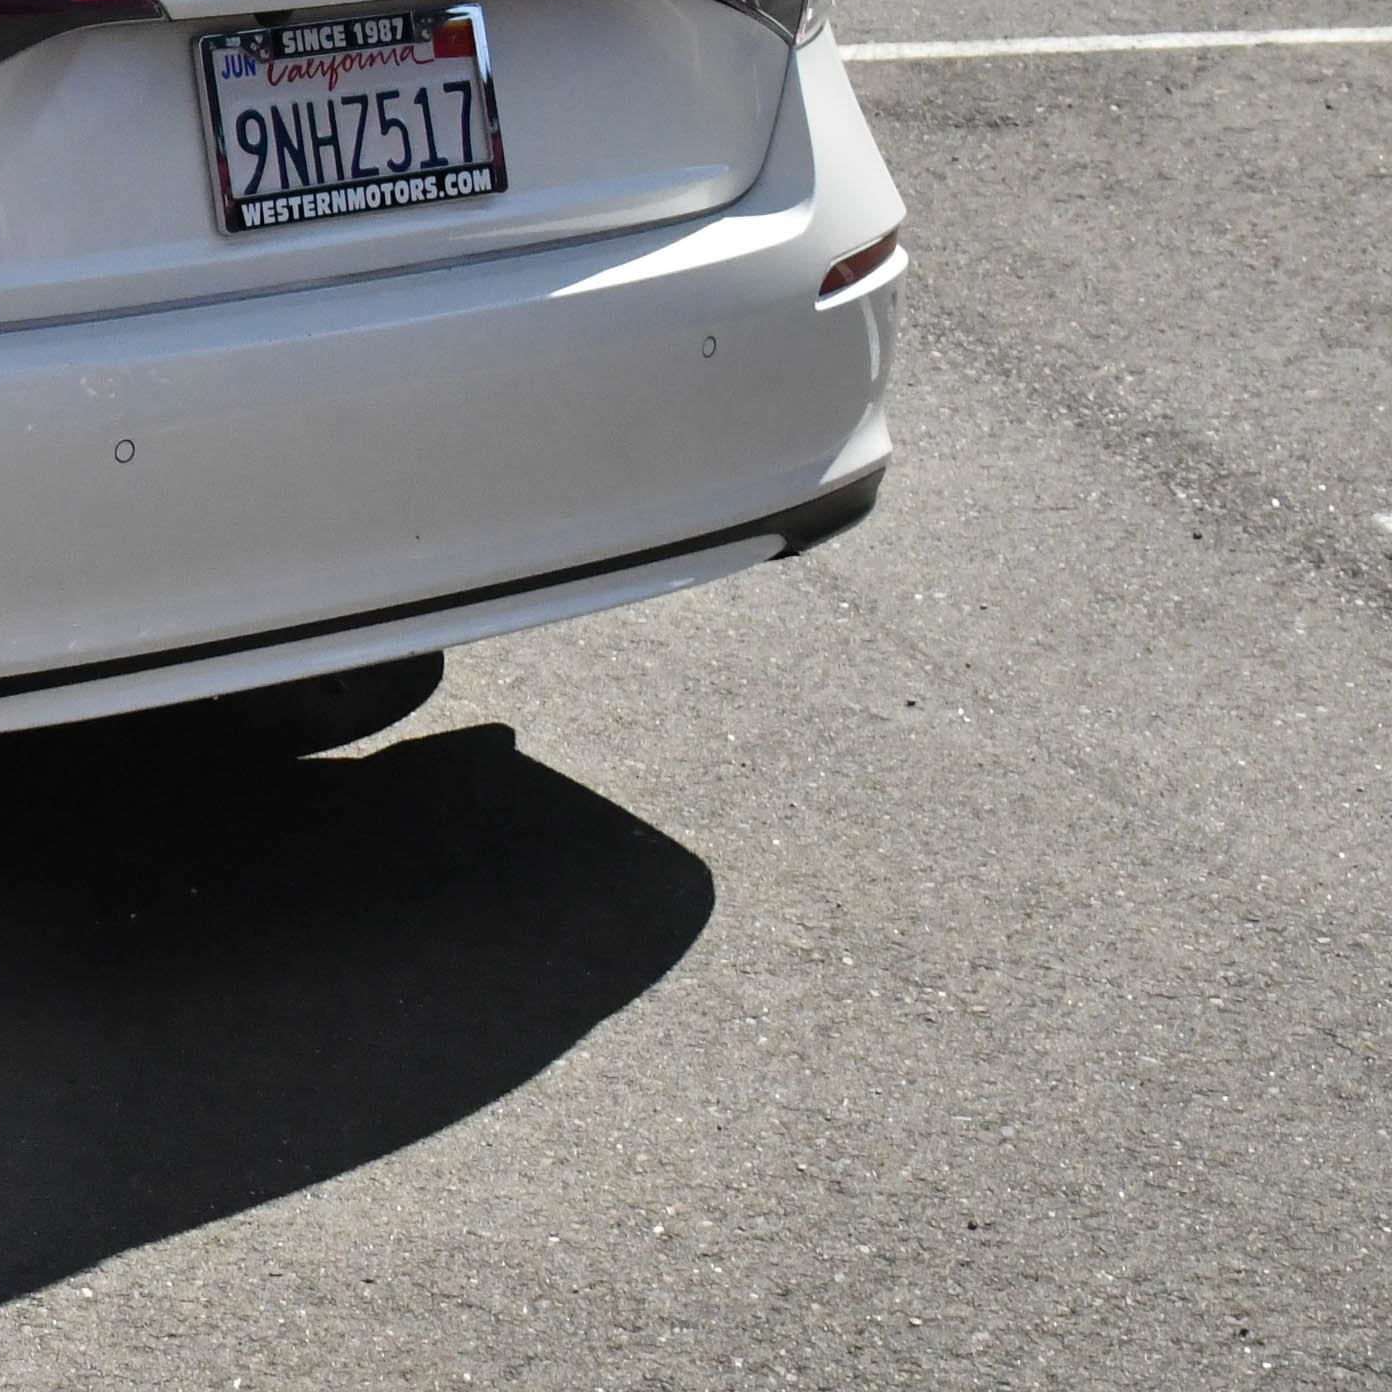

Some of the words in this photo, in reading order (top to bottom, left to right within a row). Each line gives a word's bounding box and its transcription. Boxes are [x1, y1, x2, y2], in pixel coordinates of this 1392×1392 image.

[282, 23, 346, 55] SINCE
[354, 17, 405, 45] 1987
[221, 54, 257, 80] JUN
[235, 80, 473, 196] 9NHZ517
[241, 168, 493, 228] WESTERNMOTORS.COM
